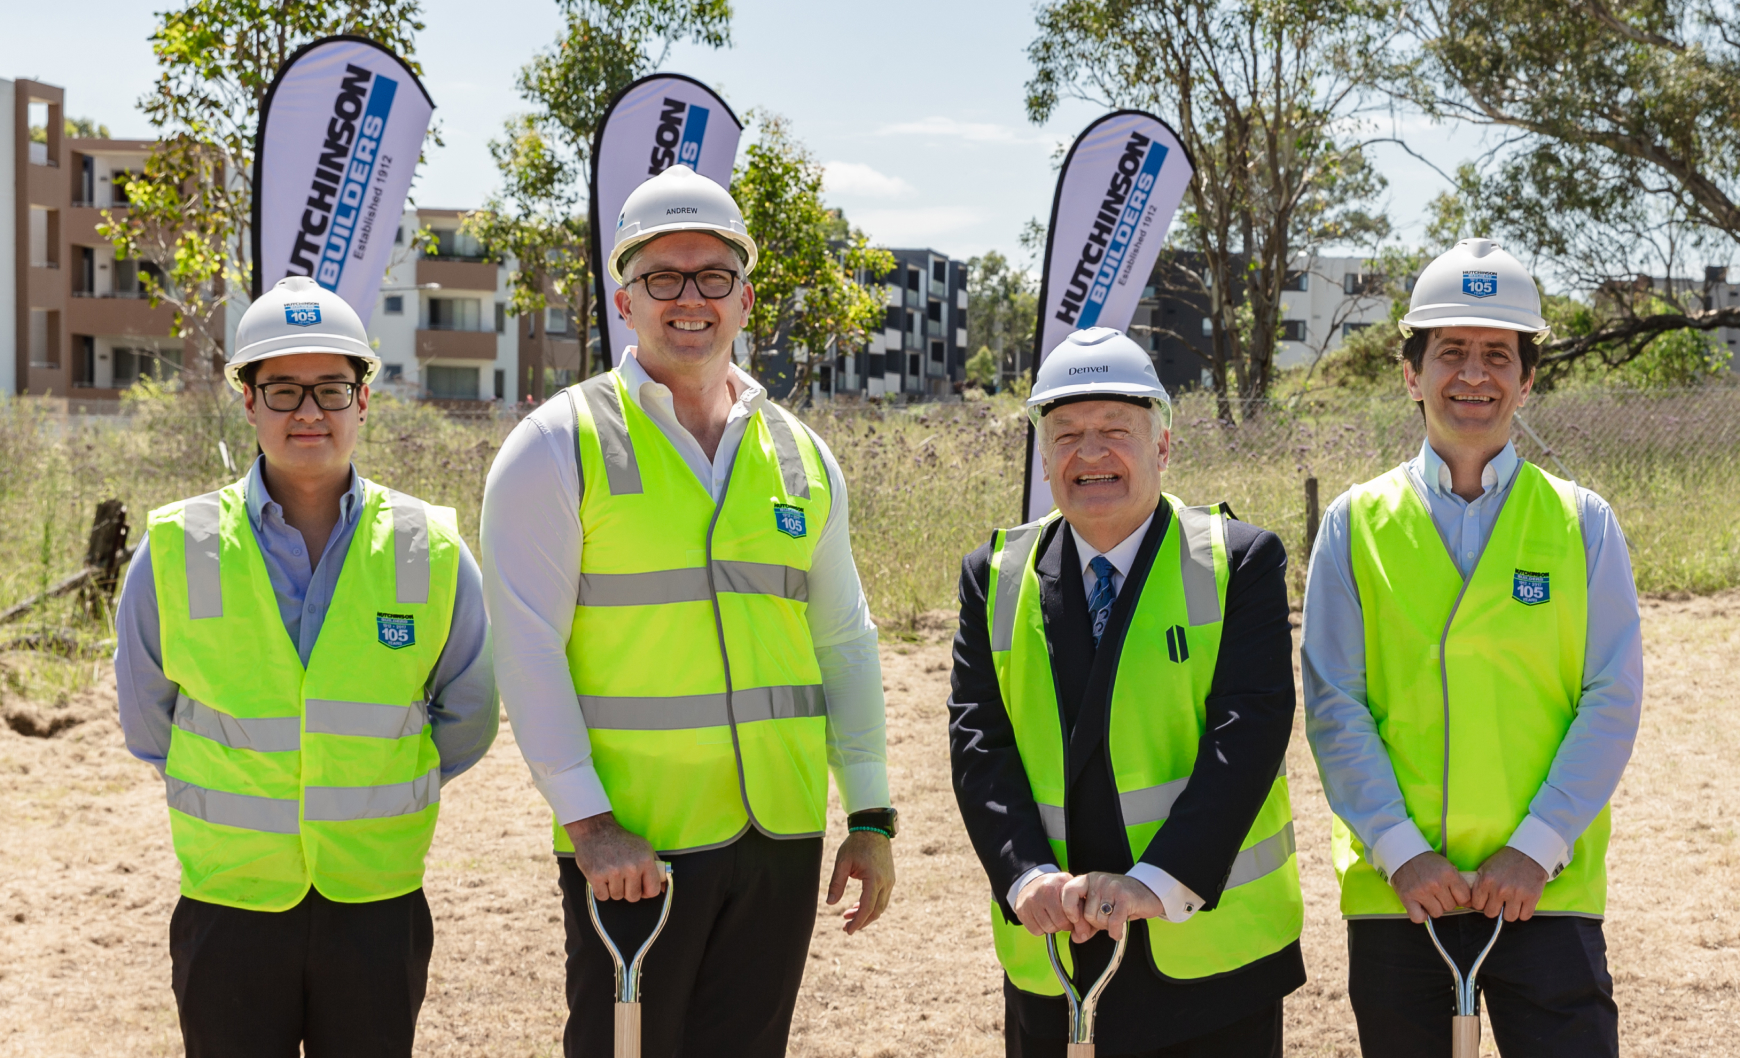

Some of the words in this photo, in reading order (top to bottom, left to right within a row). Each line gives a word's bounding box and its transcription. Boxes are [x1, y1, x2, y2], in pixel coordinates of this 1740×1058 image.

[286, 64, 372, 277] UTCHINSON
[319, 115, 383, 286] BUILDERS
[353, 187, 383, 260] Established
[376, 155, 393, 183] 1912
[666, 207, 698, 215] ANDREW
[1055, 131, 1150, 326] HUTCHINSON
[1090, 172, 1154, 305] BUILDERS
[1118, 230, 1147, 286] Established
[1142, 205, 1158, 228] 1912
[1468, 282, 1492, 292] 105
[291, 312, 317, 321] 105
[782, 517, 802, 532] 105
[1517, 585, 1543, 598] 105
[382, 628, 408, 642] 105
